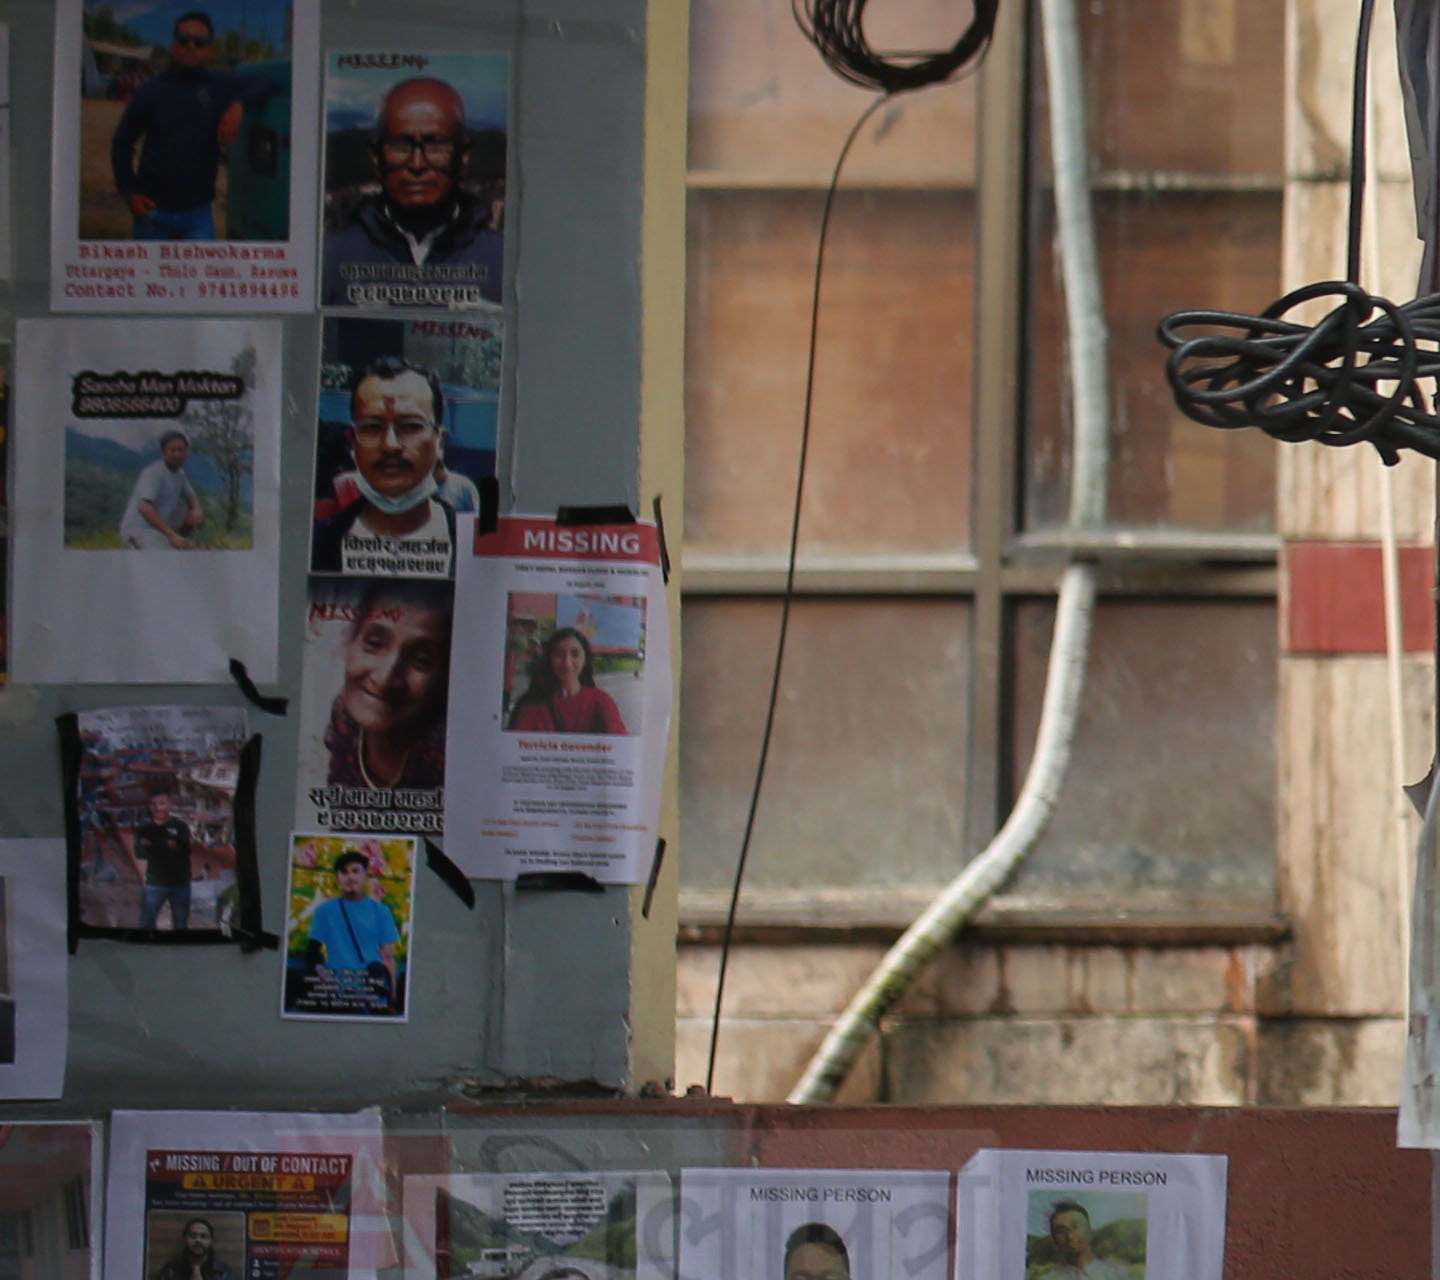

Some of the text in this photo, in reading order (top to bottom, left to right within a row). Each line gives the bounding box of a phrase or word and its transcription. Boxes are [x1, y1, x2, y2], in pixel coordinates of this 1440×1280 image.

[79, 245, 287, 260] Bikash Bishwokarma
[64, 283, 298, 297] Contact 9741894496
[523, 530, 640, 554] MISSING
[165, 1156, 349, 1175] MISSING OUT OF CONTACT
[1027, 1168, 1168, 1185] MISSING PERSON
[750, 1187, 891, 1202] MISSING PERSON
